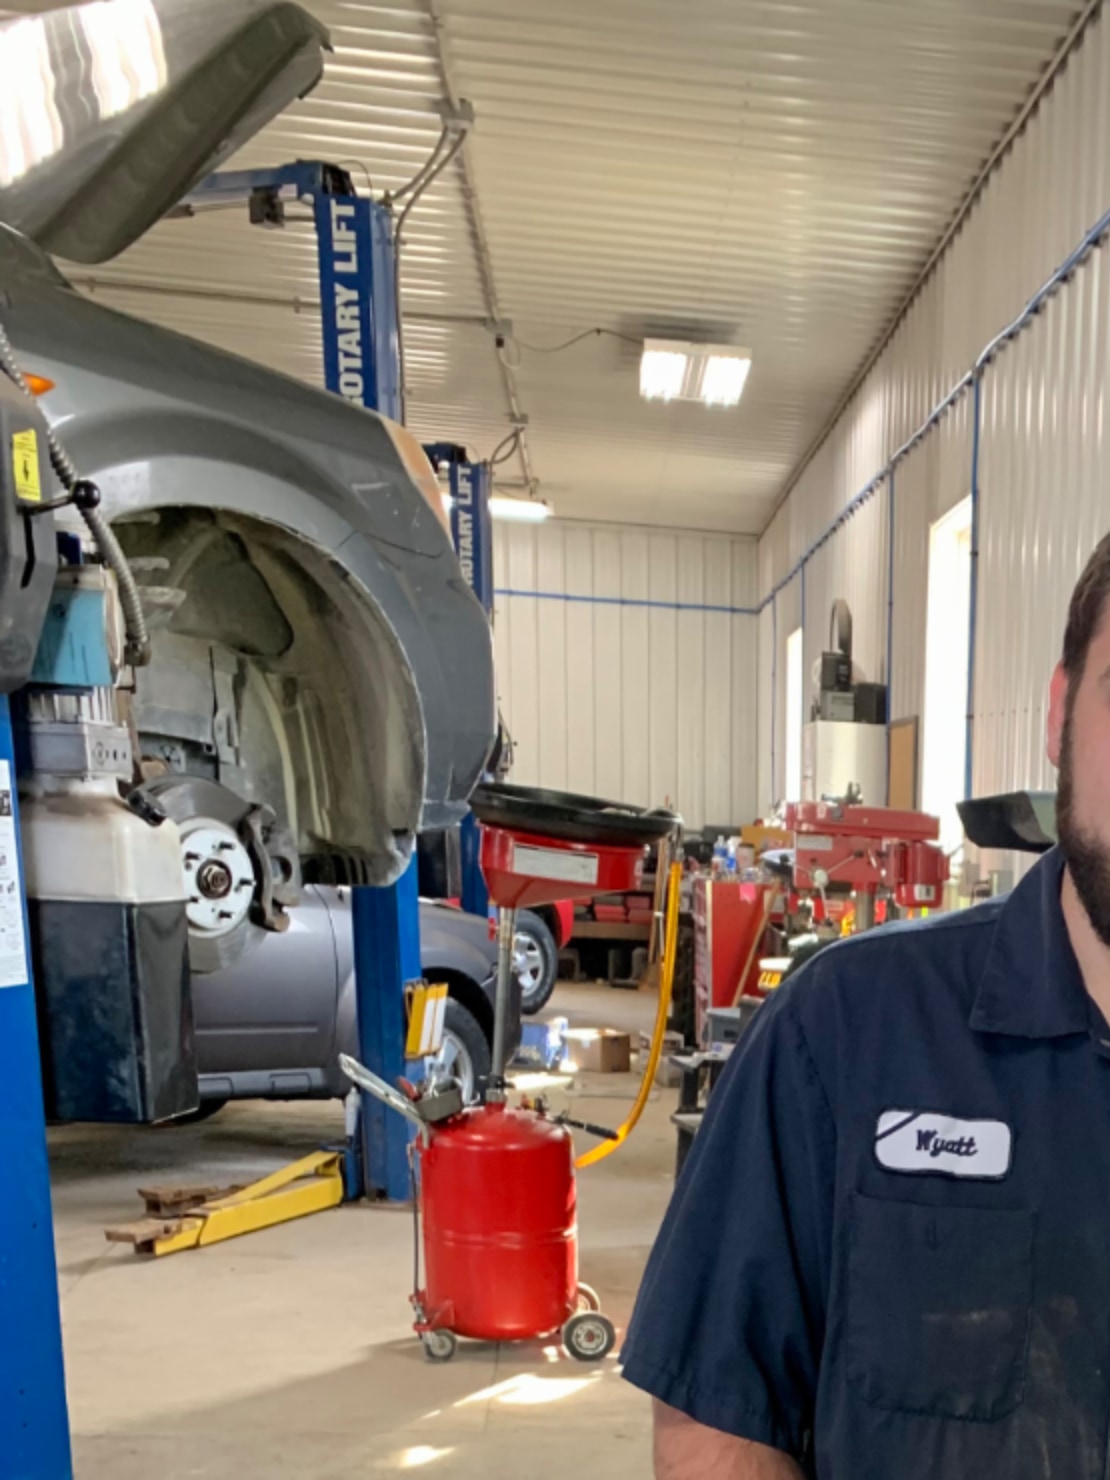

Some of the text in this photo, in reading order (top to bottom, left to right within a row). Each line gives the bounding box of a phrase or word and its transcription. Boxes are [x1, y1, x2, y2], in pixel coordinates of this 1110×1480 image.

[330, 199, 358, 273] LIFT
[457, 465, 473, 506] LIFT
[916, 1129, 978, 1158] Wyatt
